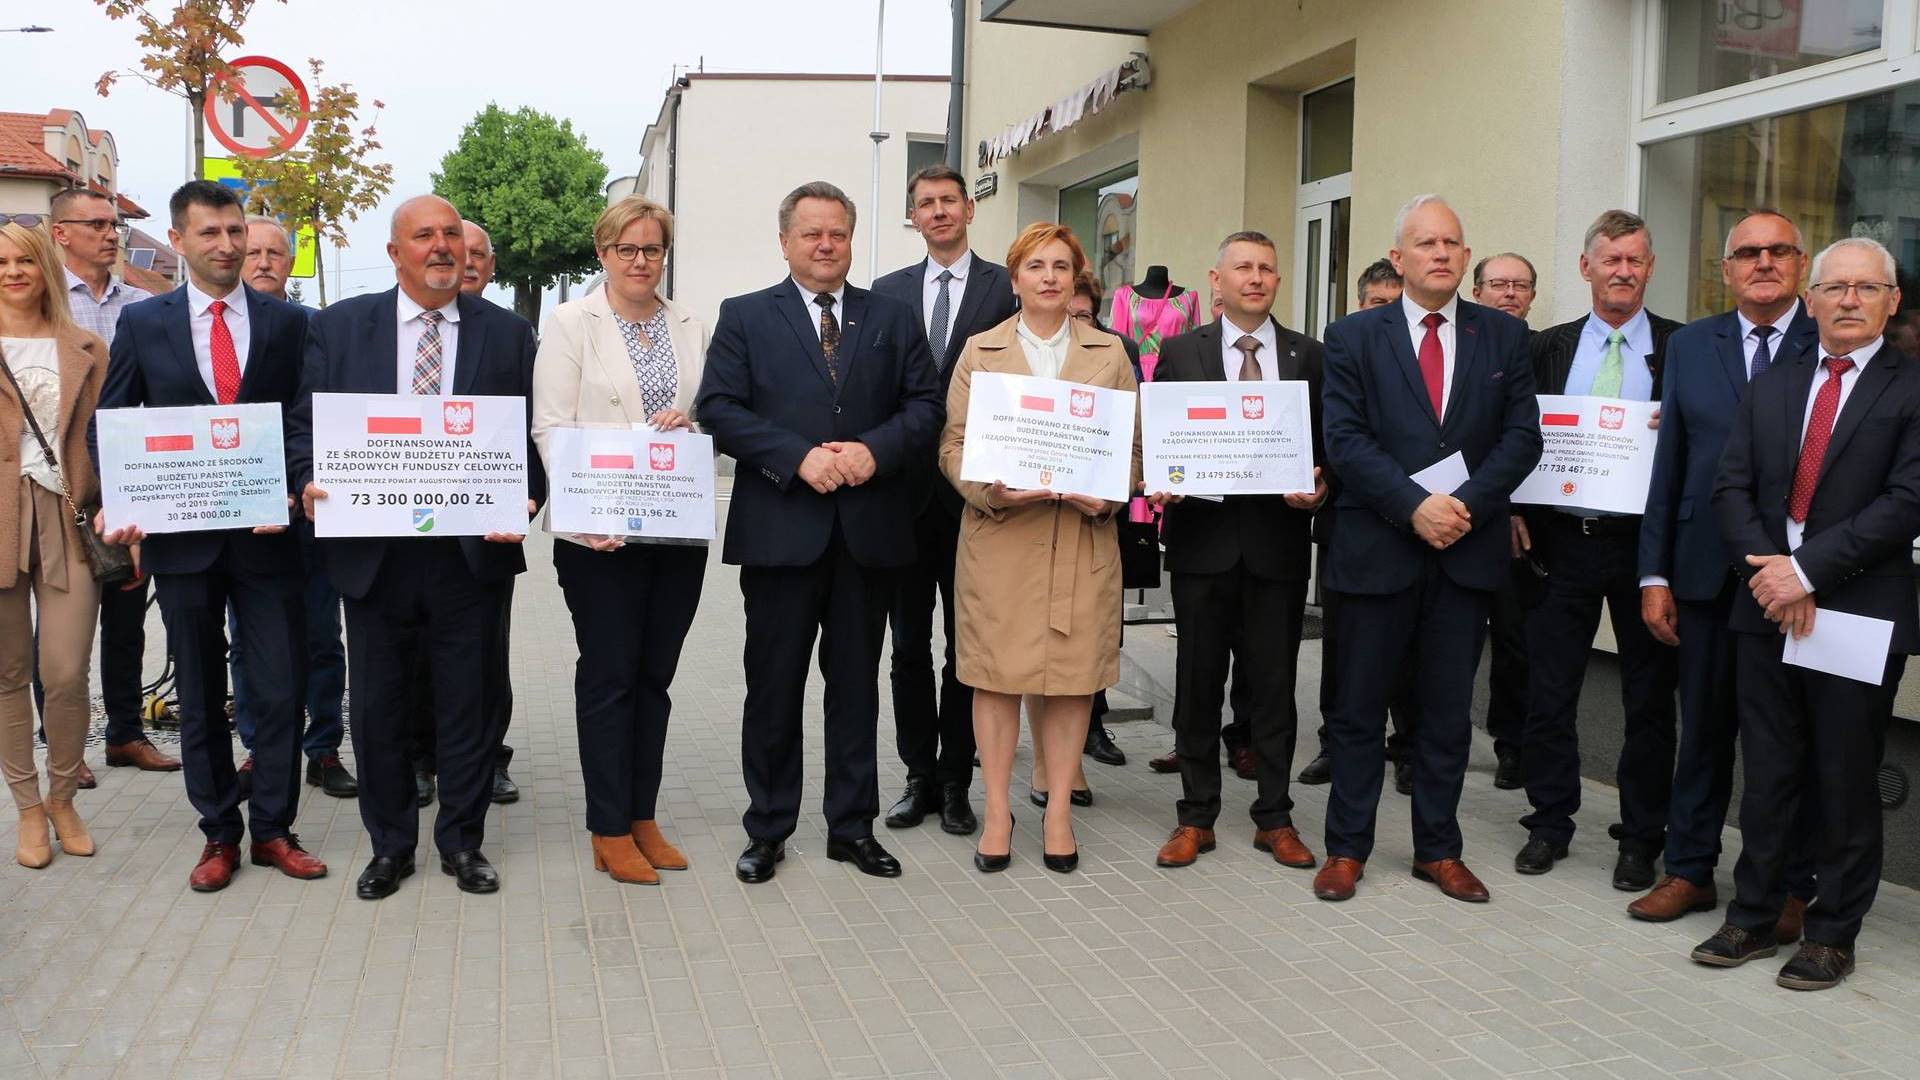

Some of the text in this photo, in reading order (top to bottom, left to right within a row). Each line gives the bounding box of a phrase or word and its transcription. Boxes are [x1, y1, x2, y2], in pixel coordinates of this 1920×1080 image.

[1072, 424, 1110, 436] ŚRODKÓW
[367, 440, 472, 448] DOFINANSOWANIA
[1034, 440, 1070, 450] FUNDUSZY
[1072, 446, 1112, 457] CELOWYCH
[1600, 443, 1639, 452] CELOWYCH
[327, 449, 511, 460] ZE ŚRODKÓW BUDŻETU PAŃSTWA
[125, 460, 204, 470] DOFINANSOWANO
[327, 463, 398, 472] RZĄDOWYCH
[402, 463, 460, 471] FUNDUSZY
[1550, 464, 1565, 472] 738
[1569, 466, 1598, 474] 467,59
[157, 471, 243, 481] BUDŻETU PAŃSTWA
[572, 472, 642, 480] DOFINANSOWANIA
[124, 484, 181, 492] RZĄDOWYCH
[184, 481, 229, 489] FUNDUSZY
[232, 478, 280, 486] CELOWYCH
[132, 493, 186, 502] pozyskanych
[241, 488, 270, 496] Sztabin
[351, 493, 494, 507] 73 300 000,00 ZŁ
[663, 491, 703, 499] CELOWYCH
[181, 512, 198, 520] 284
[201, 510, 231, 519] 000,00
[628, 509, 662, 518] 013,96
